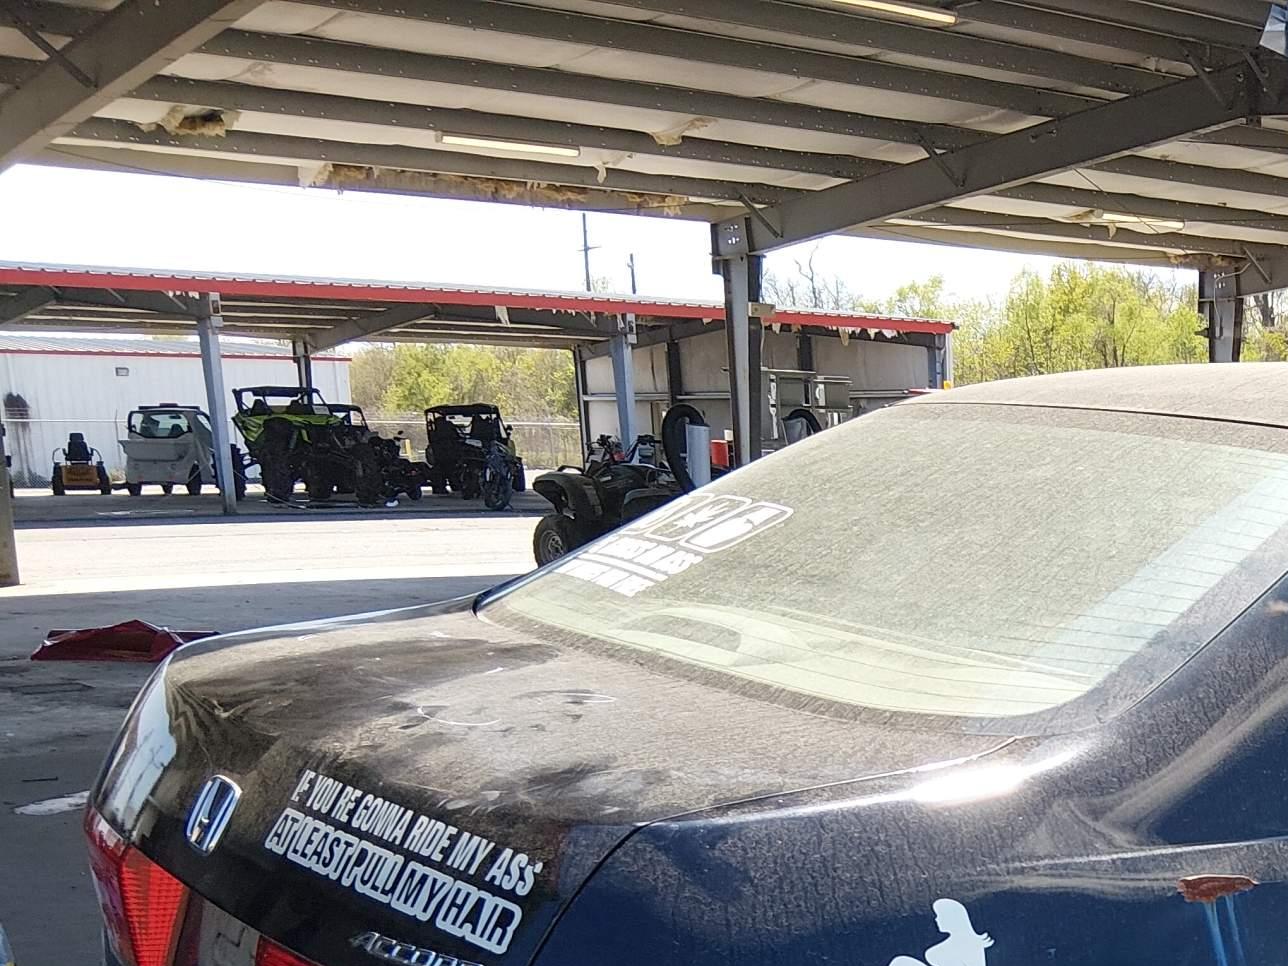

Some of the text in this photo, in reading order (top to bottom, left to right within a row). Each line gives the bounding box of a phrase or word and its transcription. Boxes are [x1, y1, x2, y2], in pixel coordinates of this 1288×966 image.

[267, 810, 520, 951] AT LEAST PULL MY HAIR
[291, 769, 317, 803] IF
[306, 773, 343, 814] YOU
[351, 794, 414, 845] GONNA
[403, 815, 458, 862] RIDE
[446, 831, 496, 876] MY
